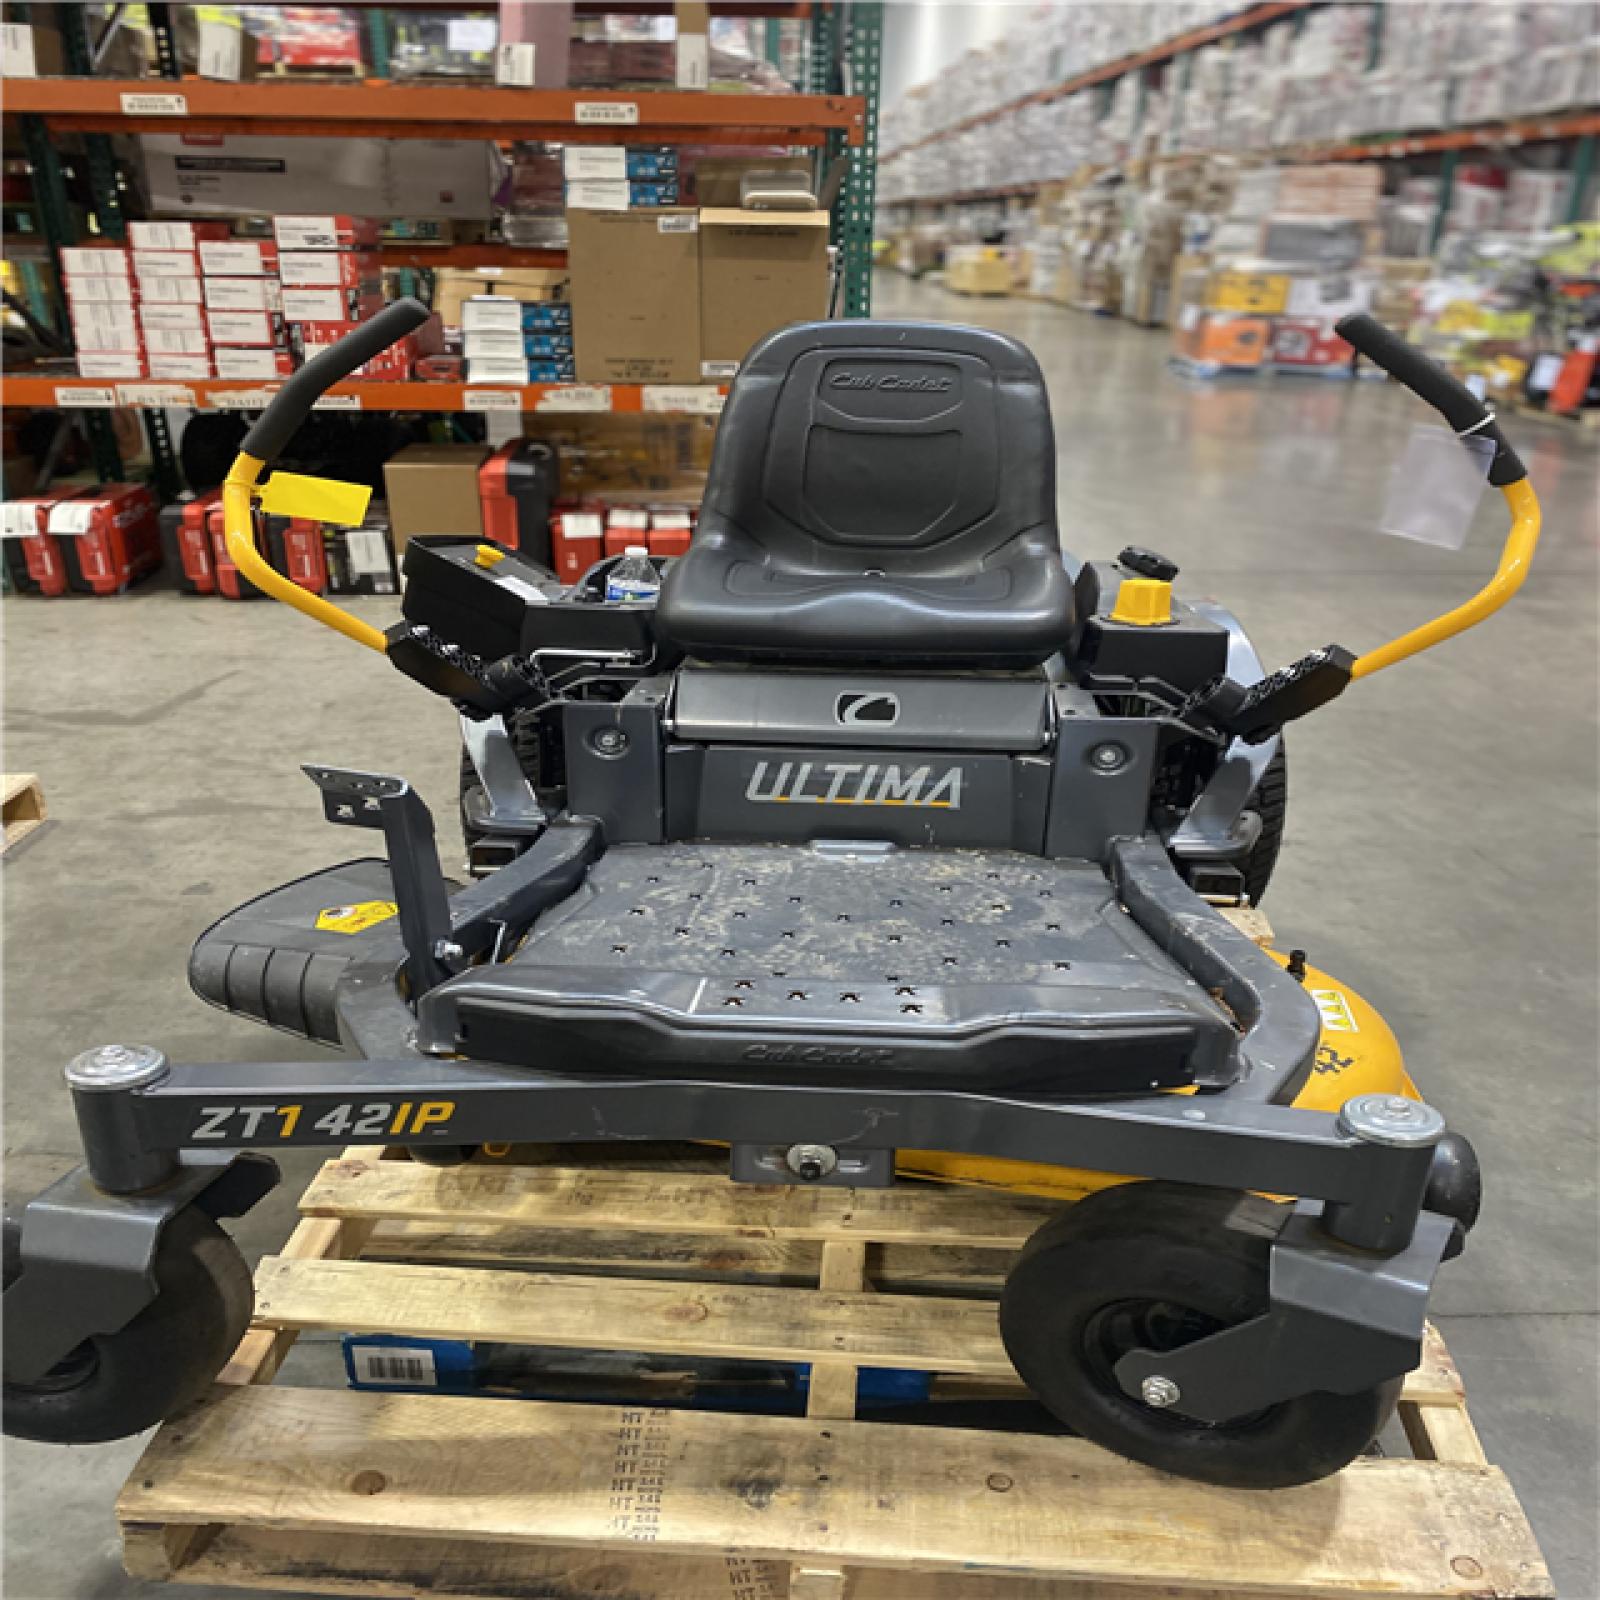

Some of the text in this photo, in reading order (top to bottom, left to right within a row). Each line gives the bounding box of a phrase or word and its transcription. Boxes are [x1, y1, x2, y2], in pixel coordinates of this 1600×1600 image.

[829, 372, 875, 391] Cub
[745, 761, 963, 810] ULTIMA
[191, 1102, 456, 1139] ZT1 42IP
